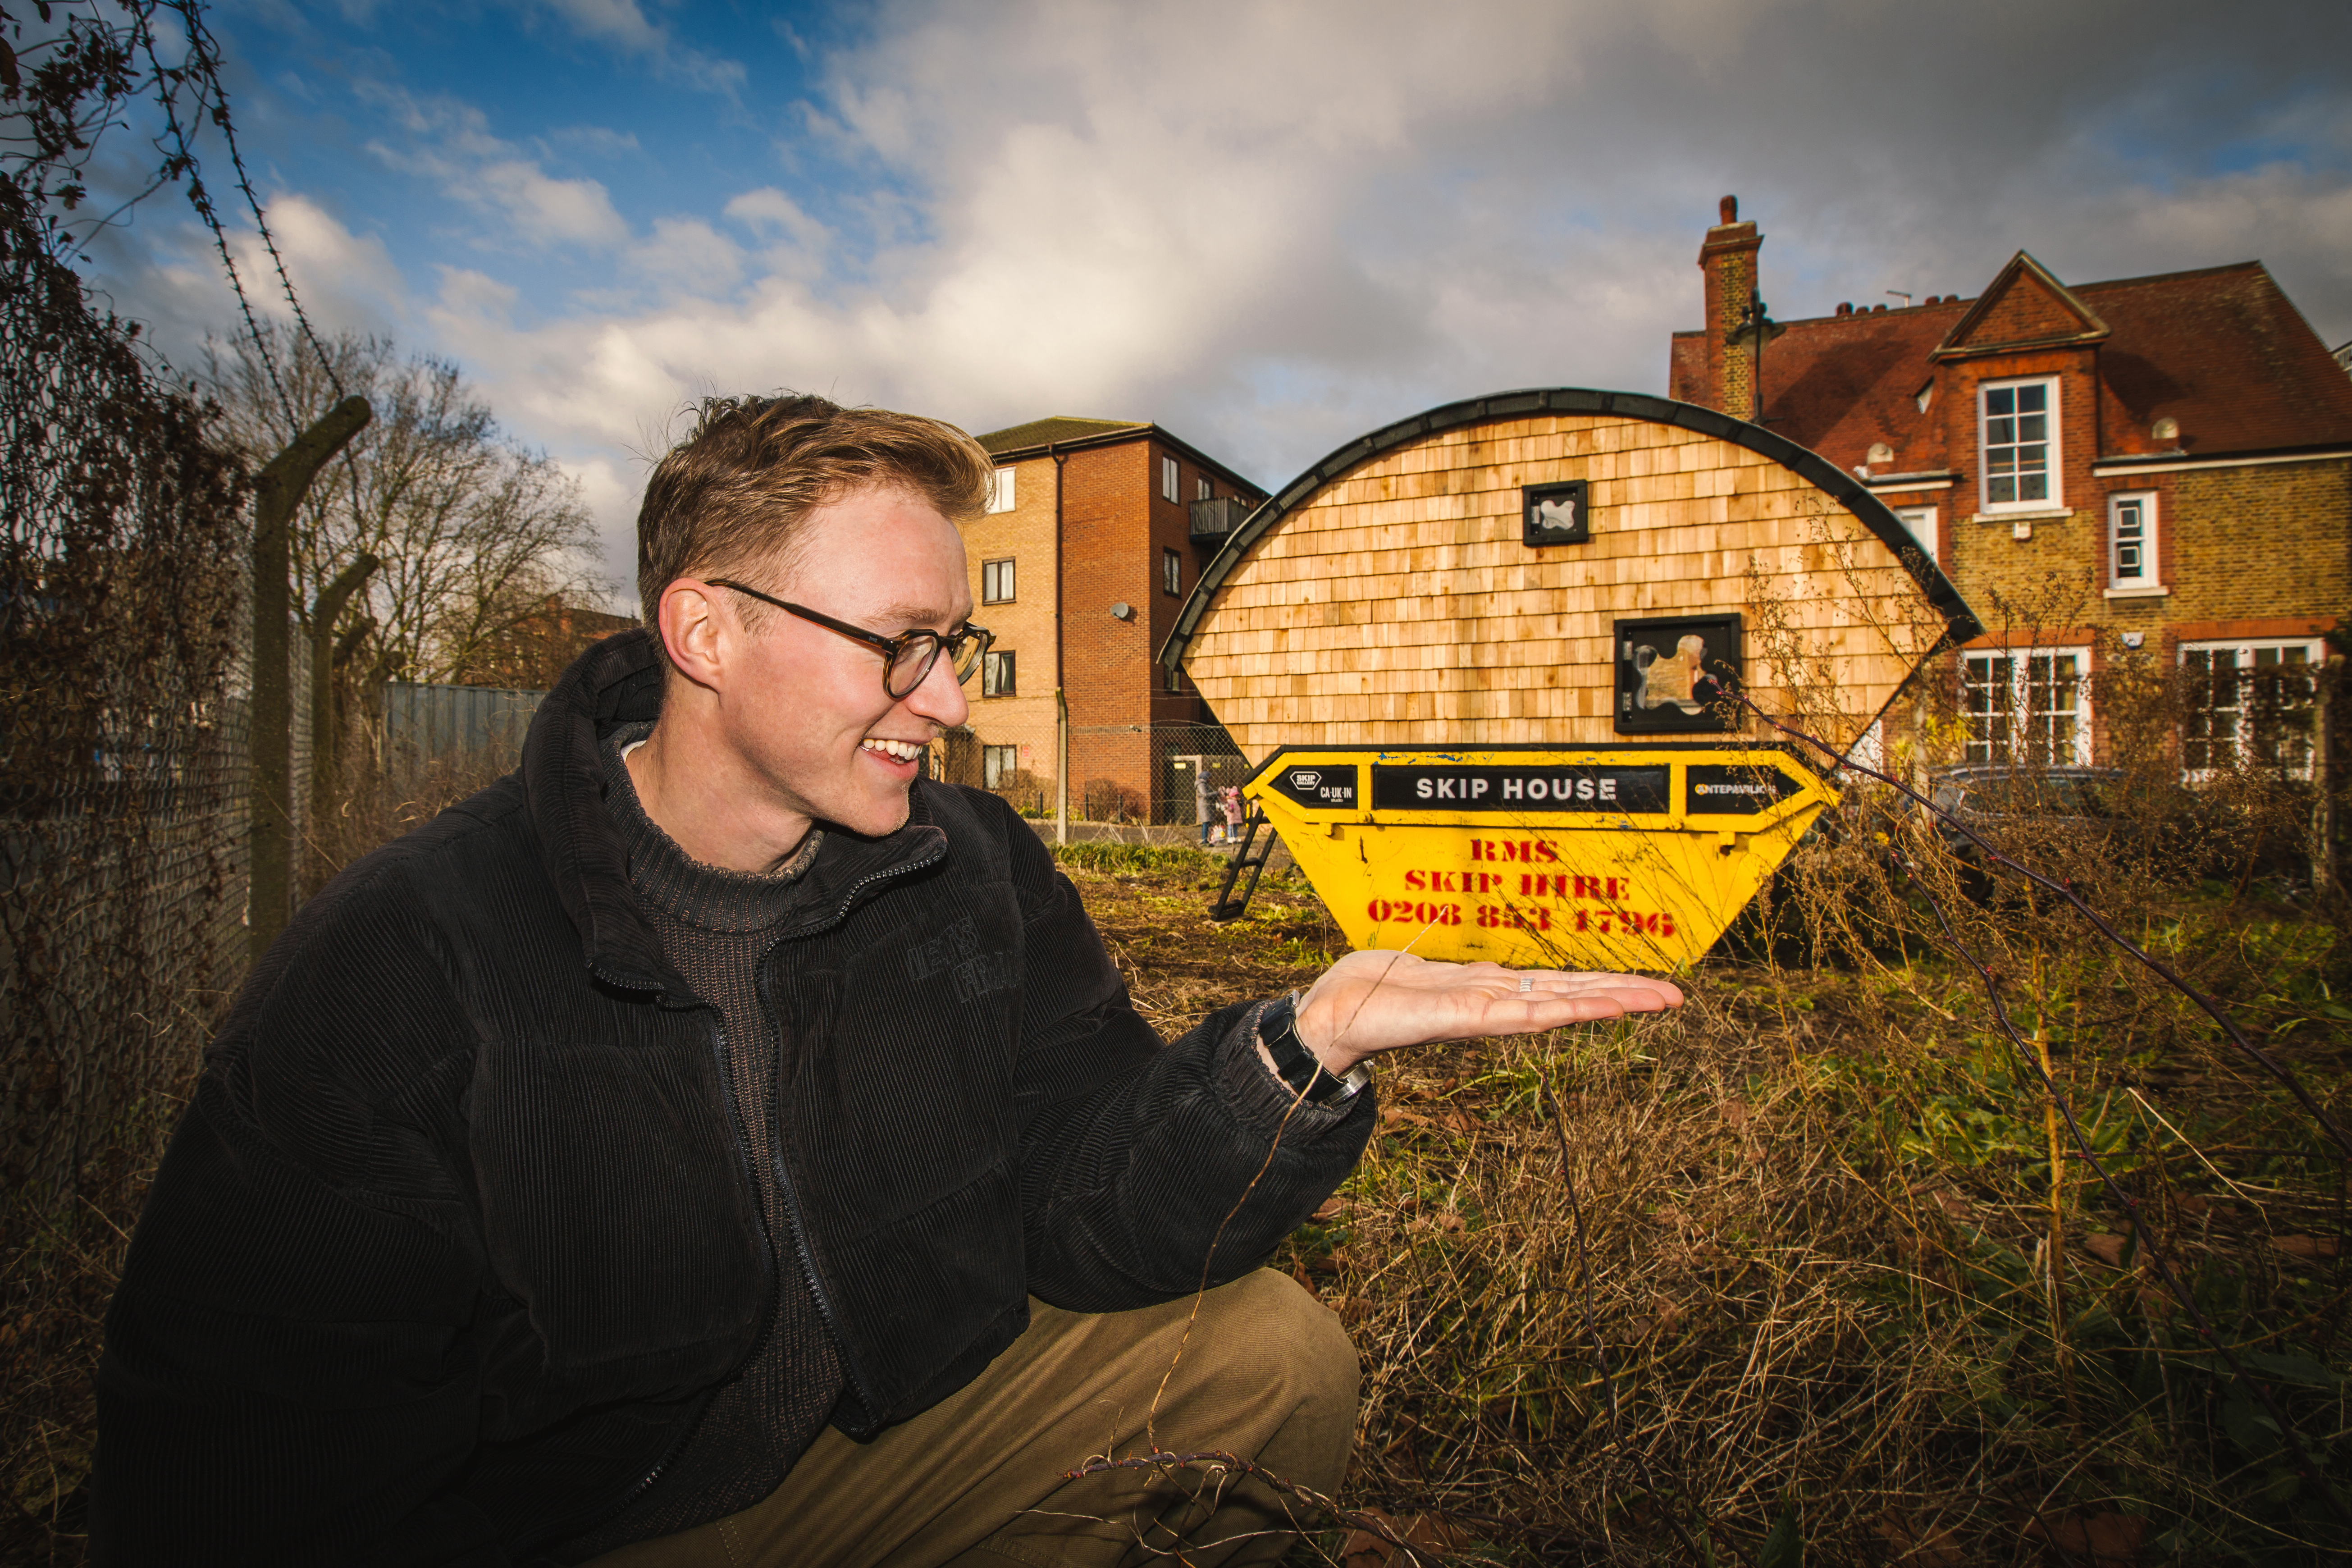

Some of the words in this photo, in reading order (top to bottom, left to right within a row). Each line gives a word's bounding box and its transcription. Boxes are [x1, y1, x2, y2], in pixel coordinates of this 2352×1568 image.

[1417, 778, 1489, 799] SKIP
[1503, 778, 1617, 800] HOUSE
[1470, 839, 1558, 863] RMS
[1405, 869, 1503, 893] SKIP
[1520, 873, 1630, 901] HIRE
[1367, 899, 1462, 926] 0208
[1477, 905, 1552, 931] 853
[1576, 910, 1676, 938] 1796
